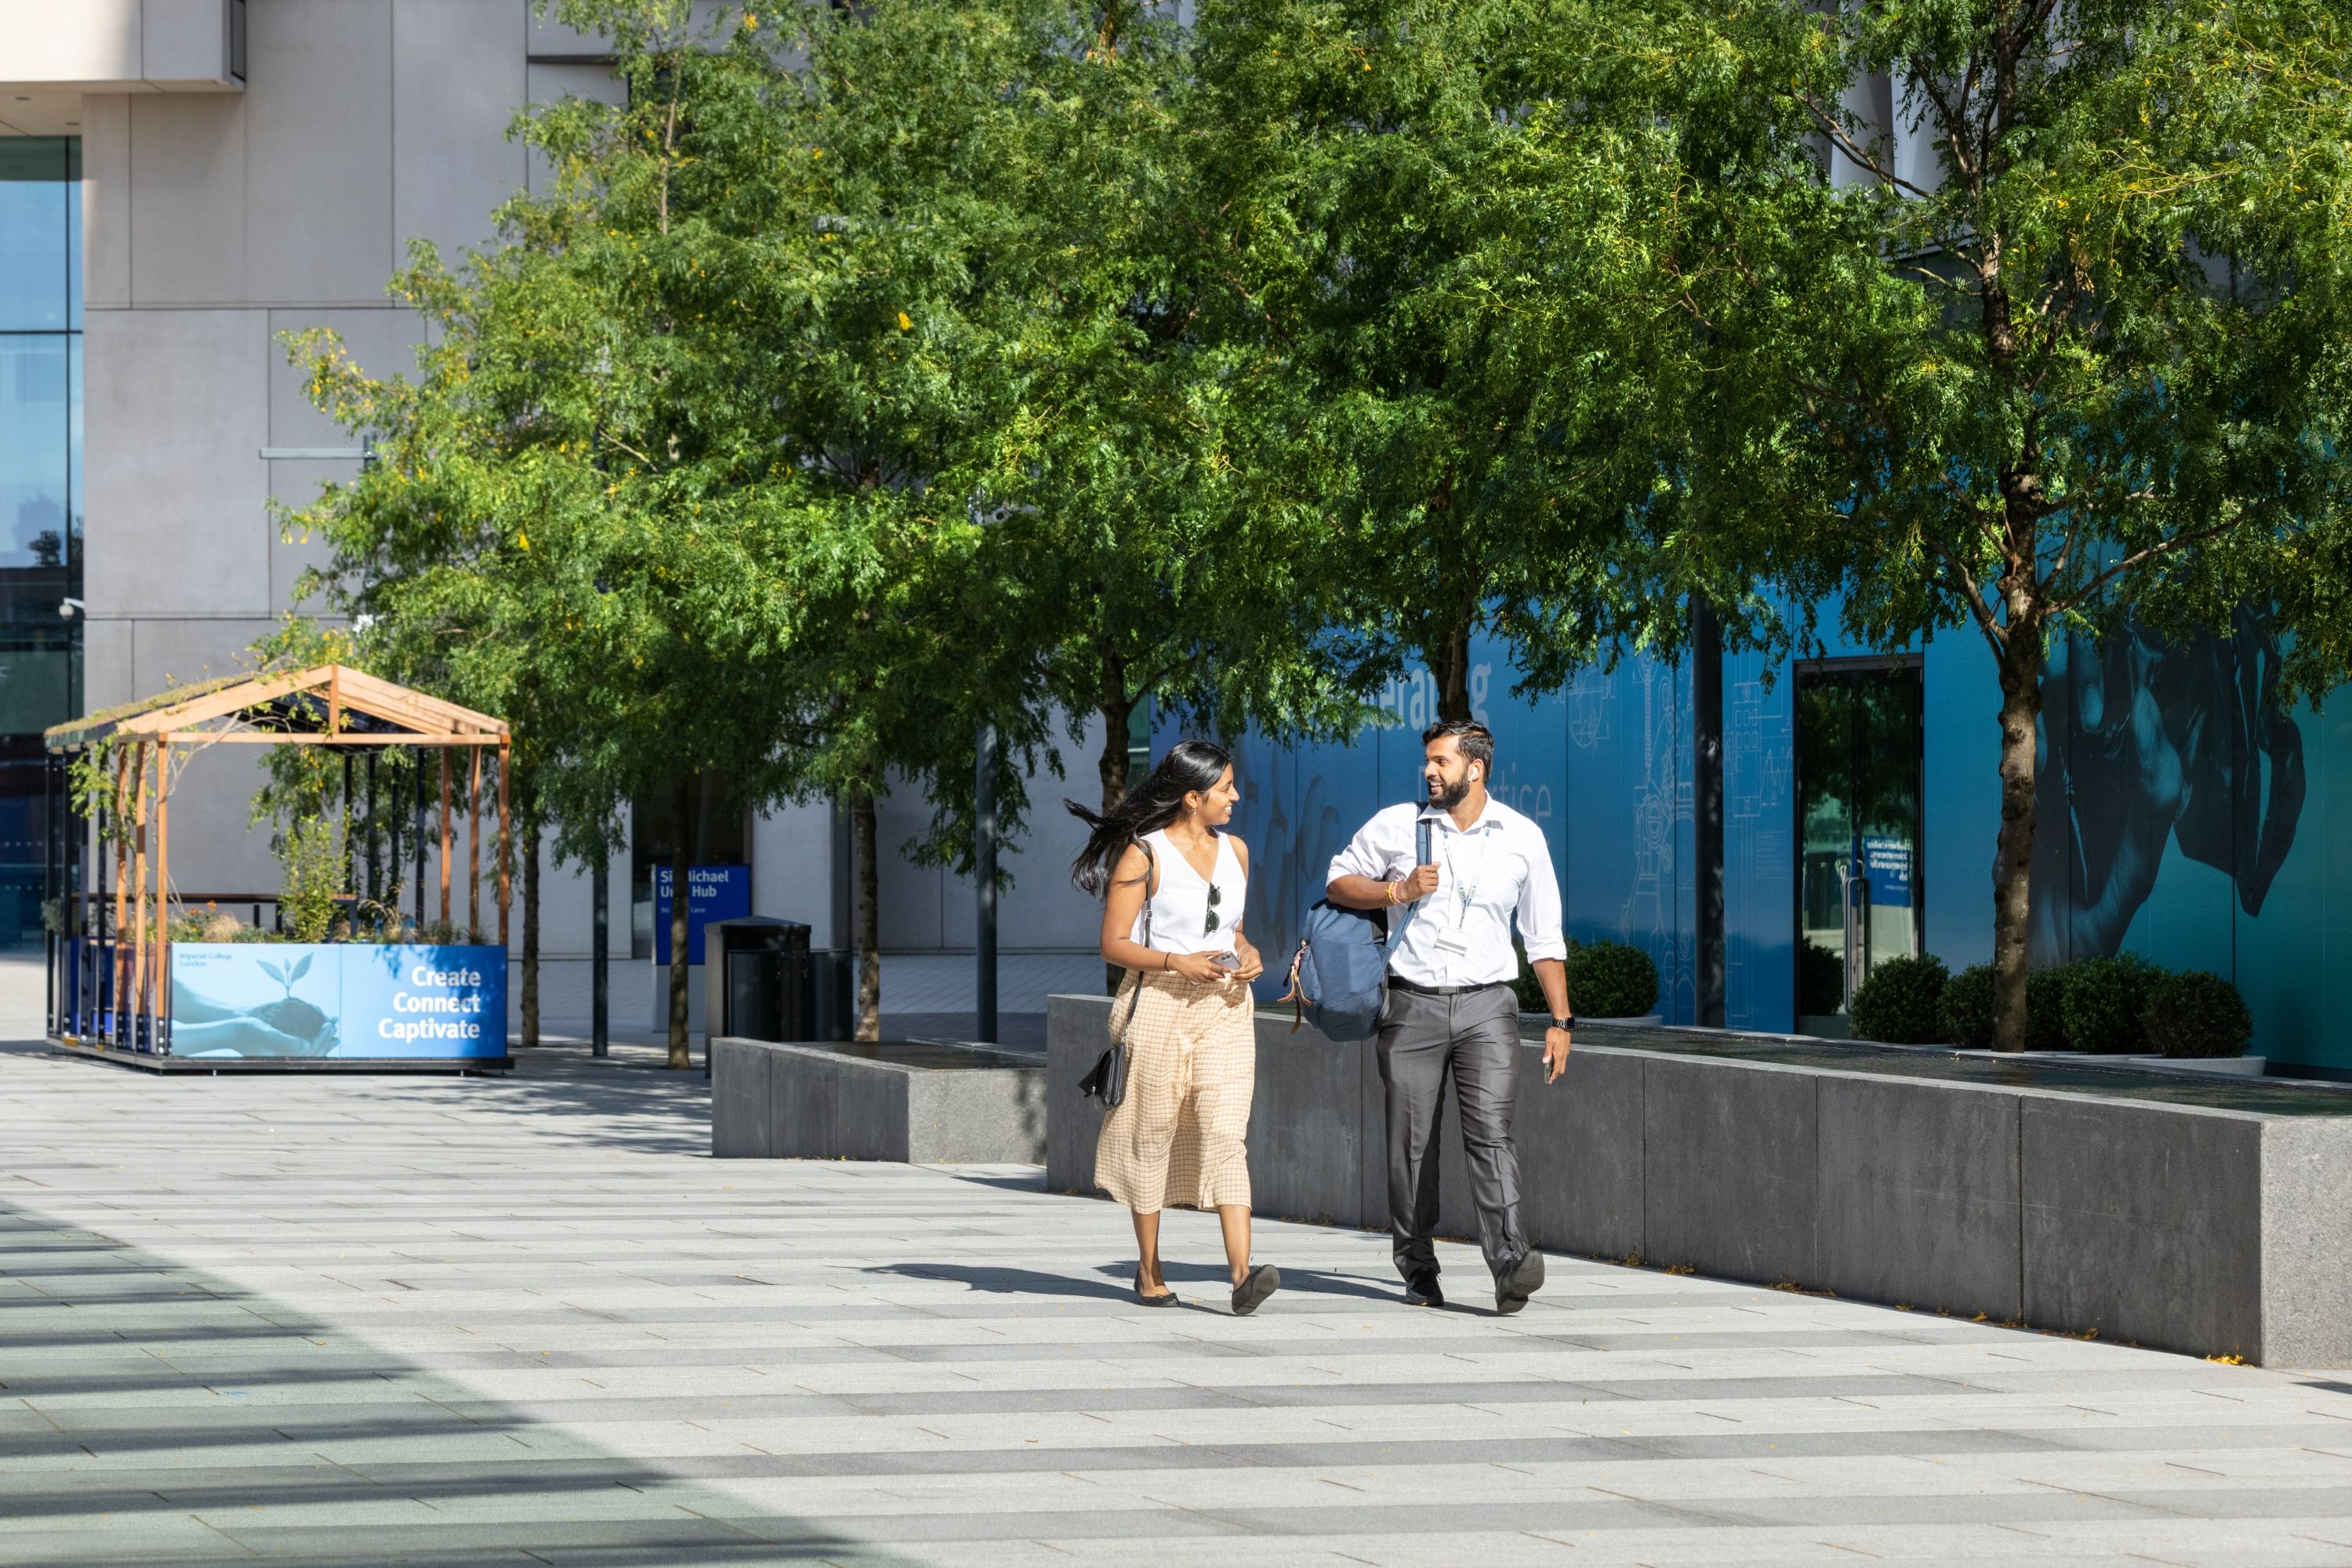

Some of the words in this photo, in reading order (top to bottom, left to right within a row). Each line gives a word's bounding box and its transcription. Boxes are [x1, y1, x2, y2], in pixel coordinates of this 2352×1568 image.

[661, 870, 673, 883] Si
[688, 870, 728, 882] ichael
[692, 885, 717, 897] Hub
[180, 953, 206, 961] Imperial
[209, 953, 232, 961] College
[412, 965, 481, 987] Create
[394, 992, 481, 1013] Connect
[379, 1018, 481, 1044] Captivate
